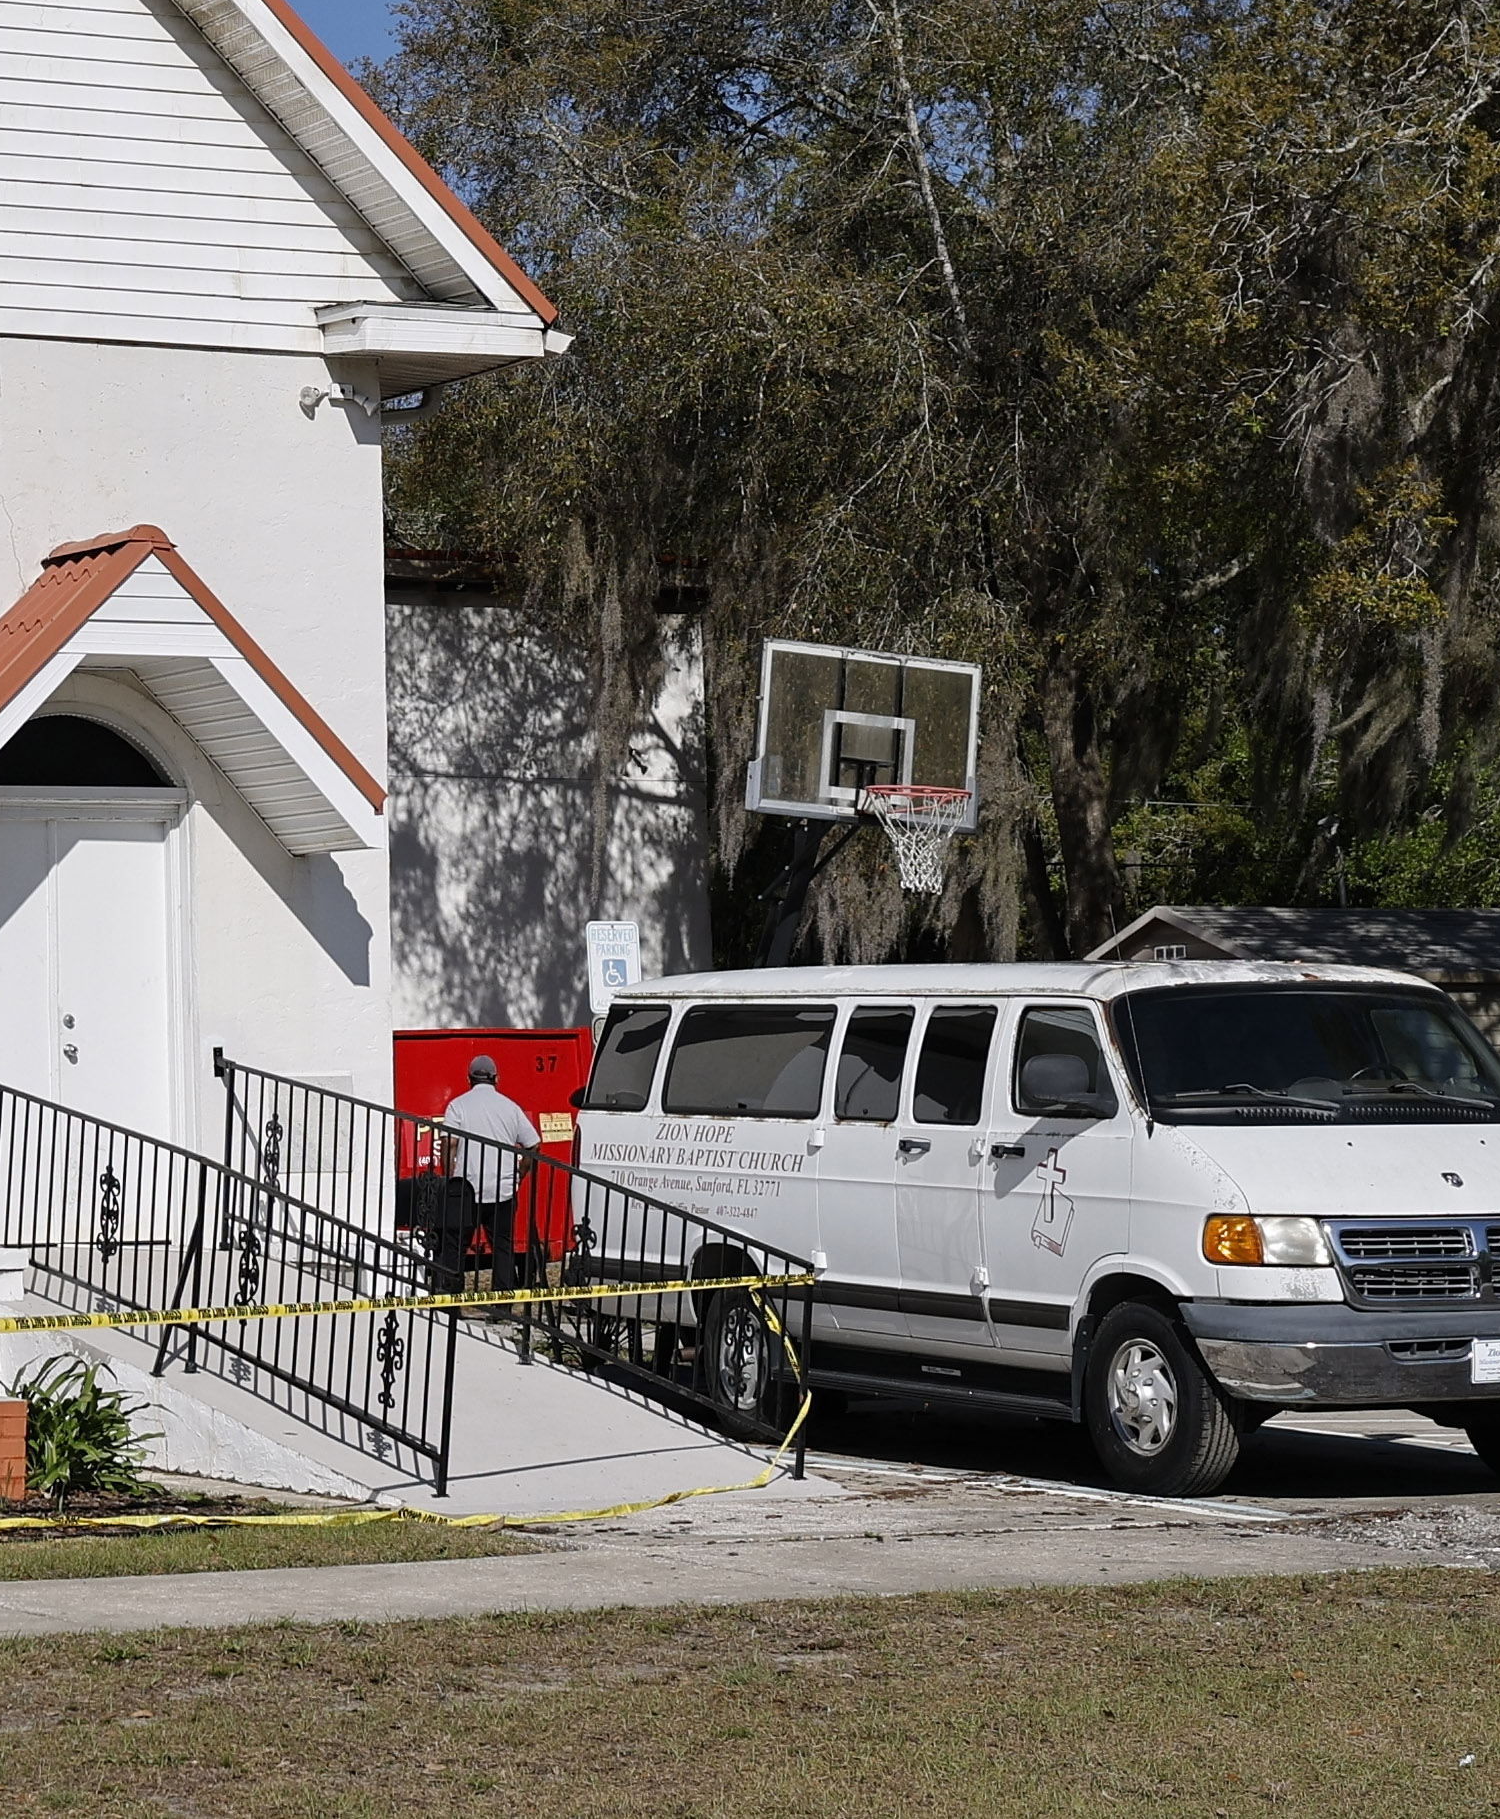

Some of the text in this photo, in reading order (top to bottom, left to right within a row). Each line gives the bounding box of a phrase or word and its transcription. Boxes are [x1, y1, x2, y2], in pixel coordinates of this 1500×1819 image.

[591, 928, 634, 942] RESERVED
[596, 943, 630, 956] PARKING
[535, 1056, 557, 1073] 37
[655, 1123, 735, 1144] ZION HOPE
[590, 1143, 805, 1172] MISSIONARY BAPTIST CHURCH
[611, 1170, 782, 1197] 710 Orange Avenue, Sanford, FL 32771
